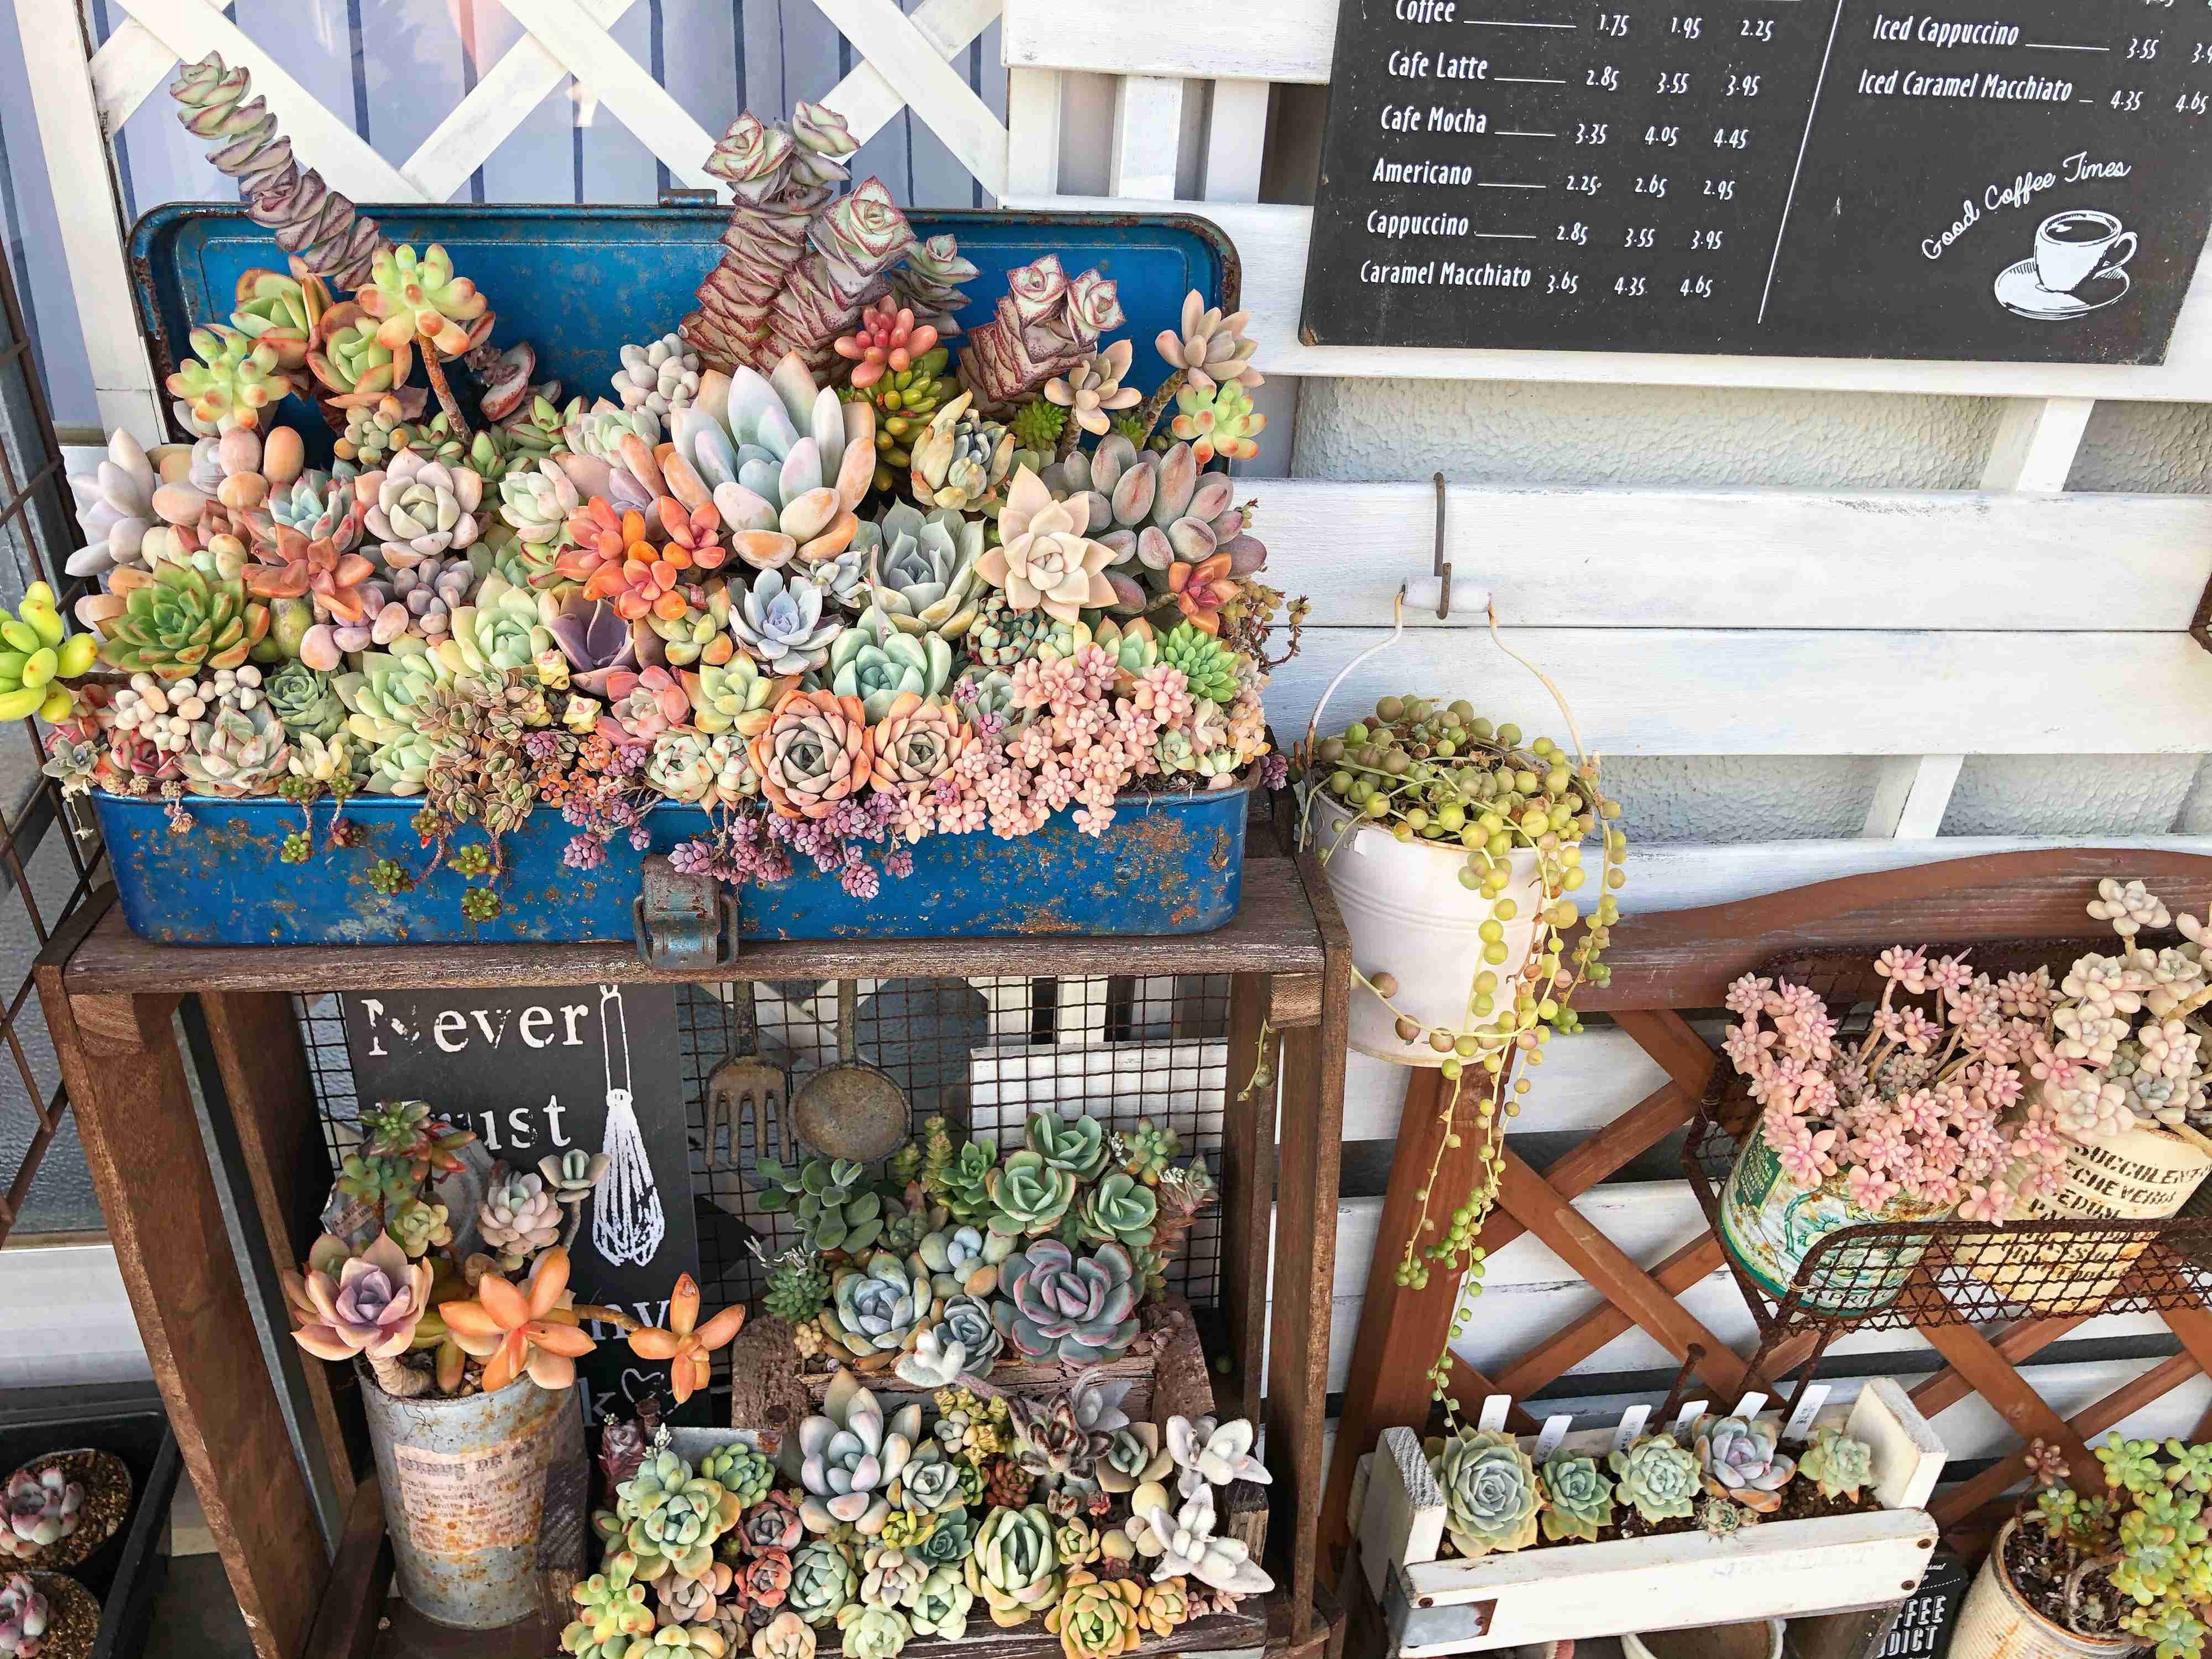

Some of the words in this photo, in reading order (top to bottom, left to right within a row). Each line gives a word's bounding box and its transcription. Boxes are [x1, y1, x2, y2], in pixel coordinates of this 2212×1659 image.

[1396, 0, 1455, 23] Coffee
[1600, 14, 1629, 36] 1.75
[1672, 17, 1702, 39] 1.95
[1741, 20, 1774, 41] 2.25
[1873, 14, 1913, 40] Iced
[1918, 17, 2019, 48] Cappuccino
[2127, 38, 2159, 59] 3.55
[1389, 51, 1428, 78] Cafe
[1437, 52, 1488, 79] Latte
[1587, 66, 1619, 91] 2.85
[1657, 72, 1689, 93] 3.55
[1726, 75, 1760, 96] 3.95
[1859, 69, 1898, 94] Iced
[1903, 71, 1979, 97] Caramel
[1981, 74, 2072, 101] Macchiato
[2110, 91, 2143, 111] 4.35
[2176, 91, 2209, 114] 4.65
[1381, 105, 1421, 132] Cafe
[1428, 106, 1486, 133] Mocha
[1575, 124, 1608, 144] 3.35
[1645, 126, 1679, 146] 4.05
[1714, 129, 1749, 149] 4.45
[1373, 158, 1472, 185] Americano
[1567, 175, 1597, 195] 2.25
[1635, 174, 1667, 197] 2.65
[1703, 180, 1735, 200] 2.95
[1922, 200, 1980, 259] Good
[1985, 172, 2056, 210] Coffee
[2063, 151, 2131, 182] Times
[1367, 210, 1468, 239] Cappuccino
[1557, 222, 1588, 245] 2.85
[1625, 228, 1655, 247] 3.55
[1691, 231, 1723, 249] 3.95
[1361, 260, 1434, 284] Caramel
[1440, 262, 1531, 286] Macchiato
[1547, 272, 1578, 294] 3.65
[1614, 277, 1645, 296] 4.35
[1680, 275, 1713, 298] 4.65
[361, 999, 588, 1055] Never
